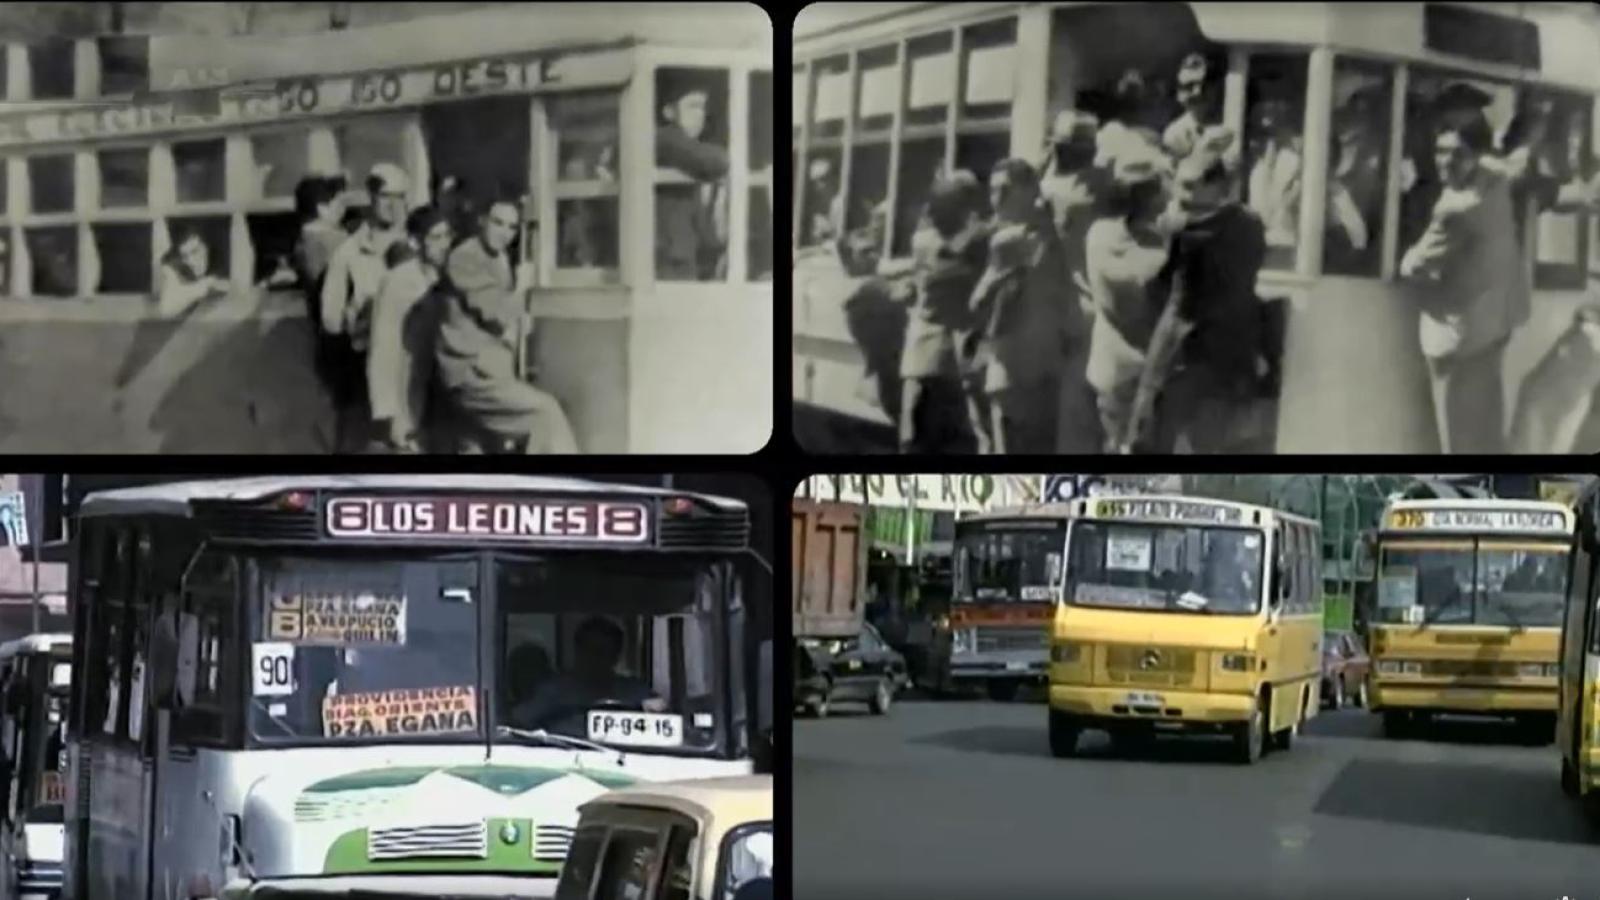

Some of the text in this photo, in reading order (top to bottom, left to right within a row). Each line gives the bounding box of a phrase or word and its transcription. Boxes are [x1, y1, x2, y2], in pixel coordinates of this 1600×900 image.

[374, 502, 434, 532] LOS
[448, 503, 587, 535] LEONES
[260, 655, 289, 687] 90
